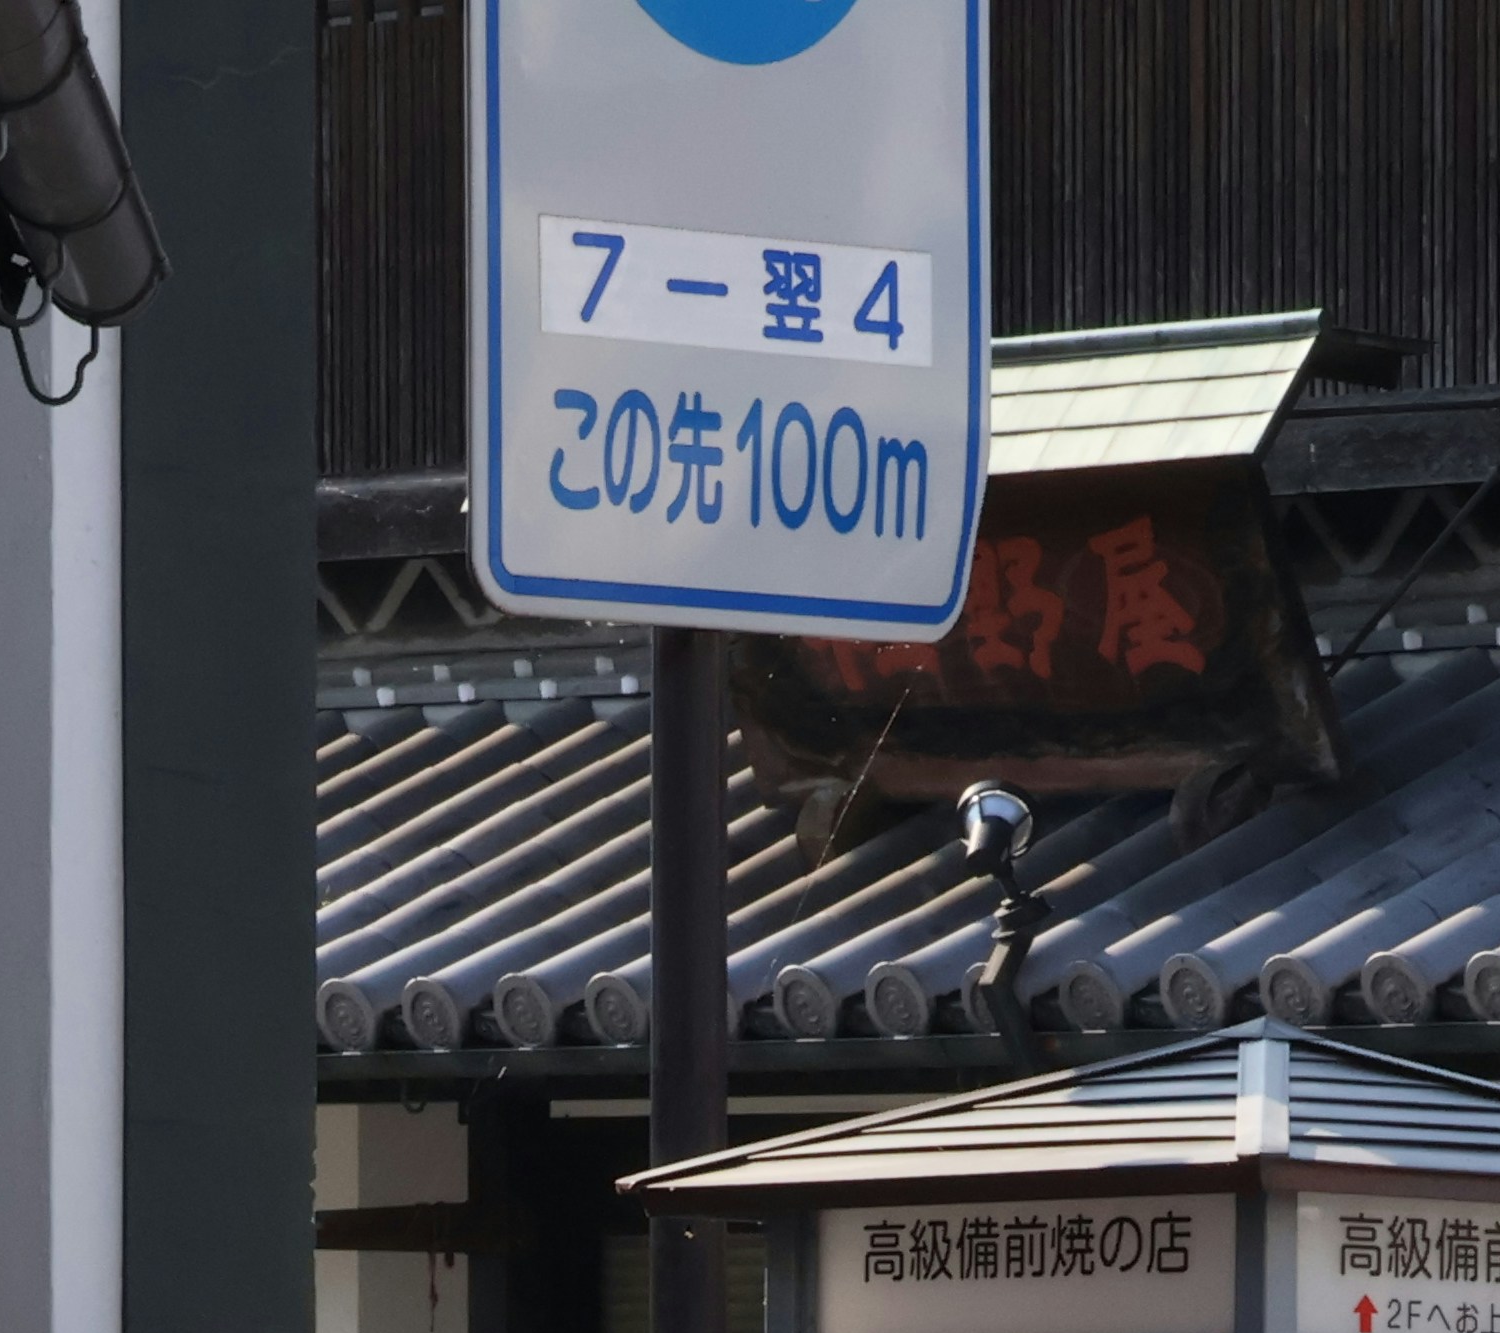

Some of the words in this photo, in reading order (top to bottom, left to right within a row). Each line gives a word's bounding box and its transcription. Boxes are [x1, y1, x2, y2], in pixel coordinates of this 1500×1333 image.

[549, 389, 927, 542] この先100m
[799, 512, 1206, 692] 野屋
[863, 1211, 1192, 1283] 高級備前焼の店
